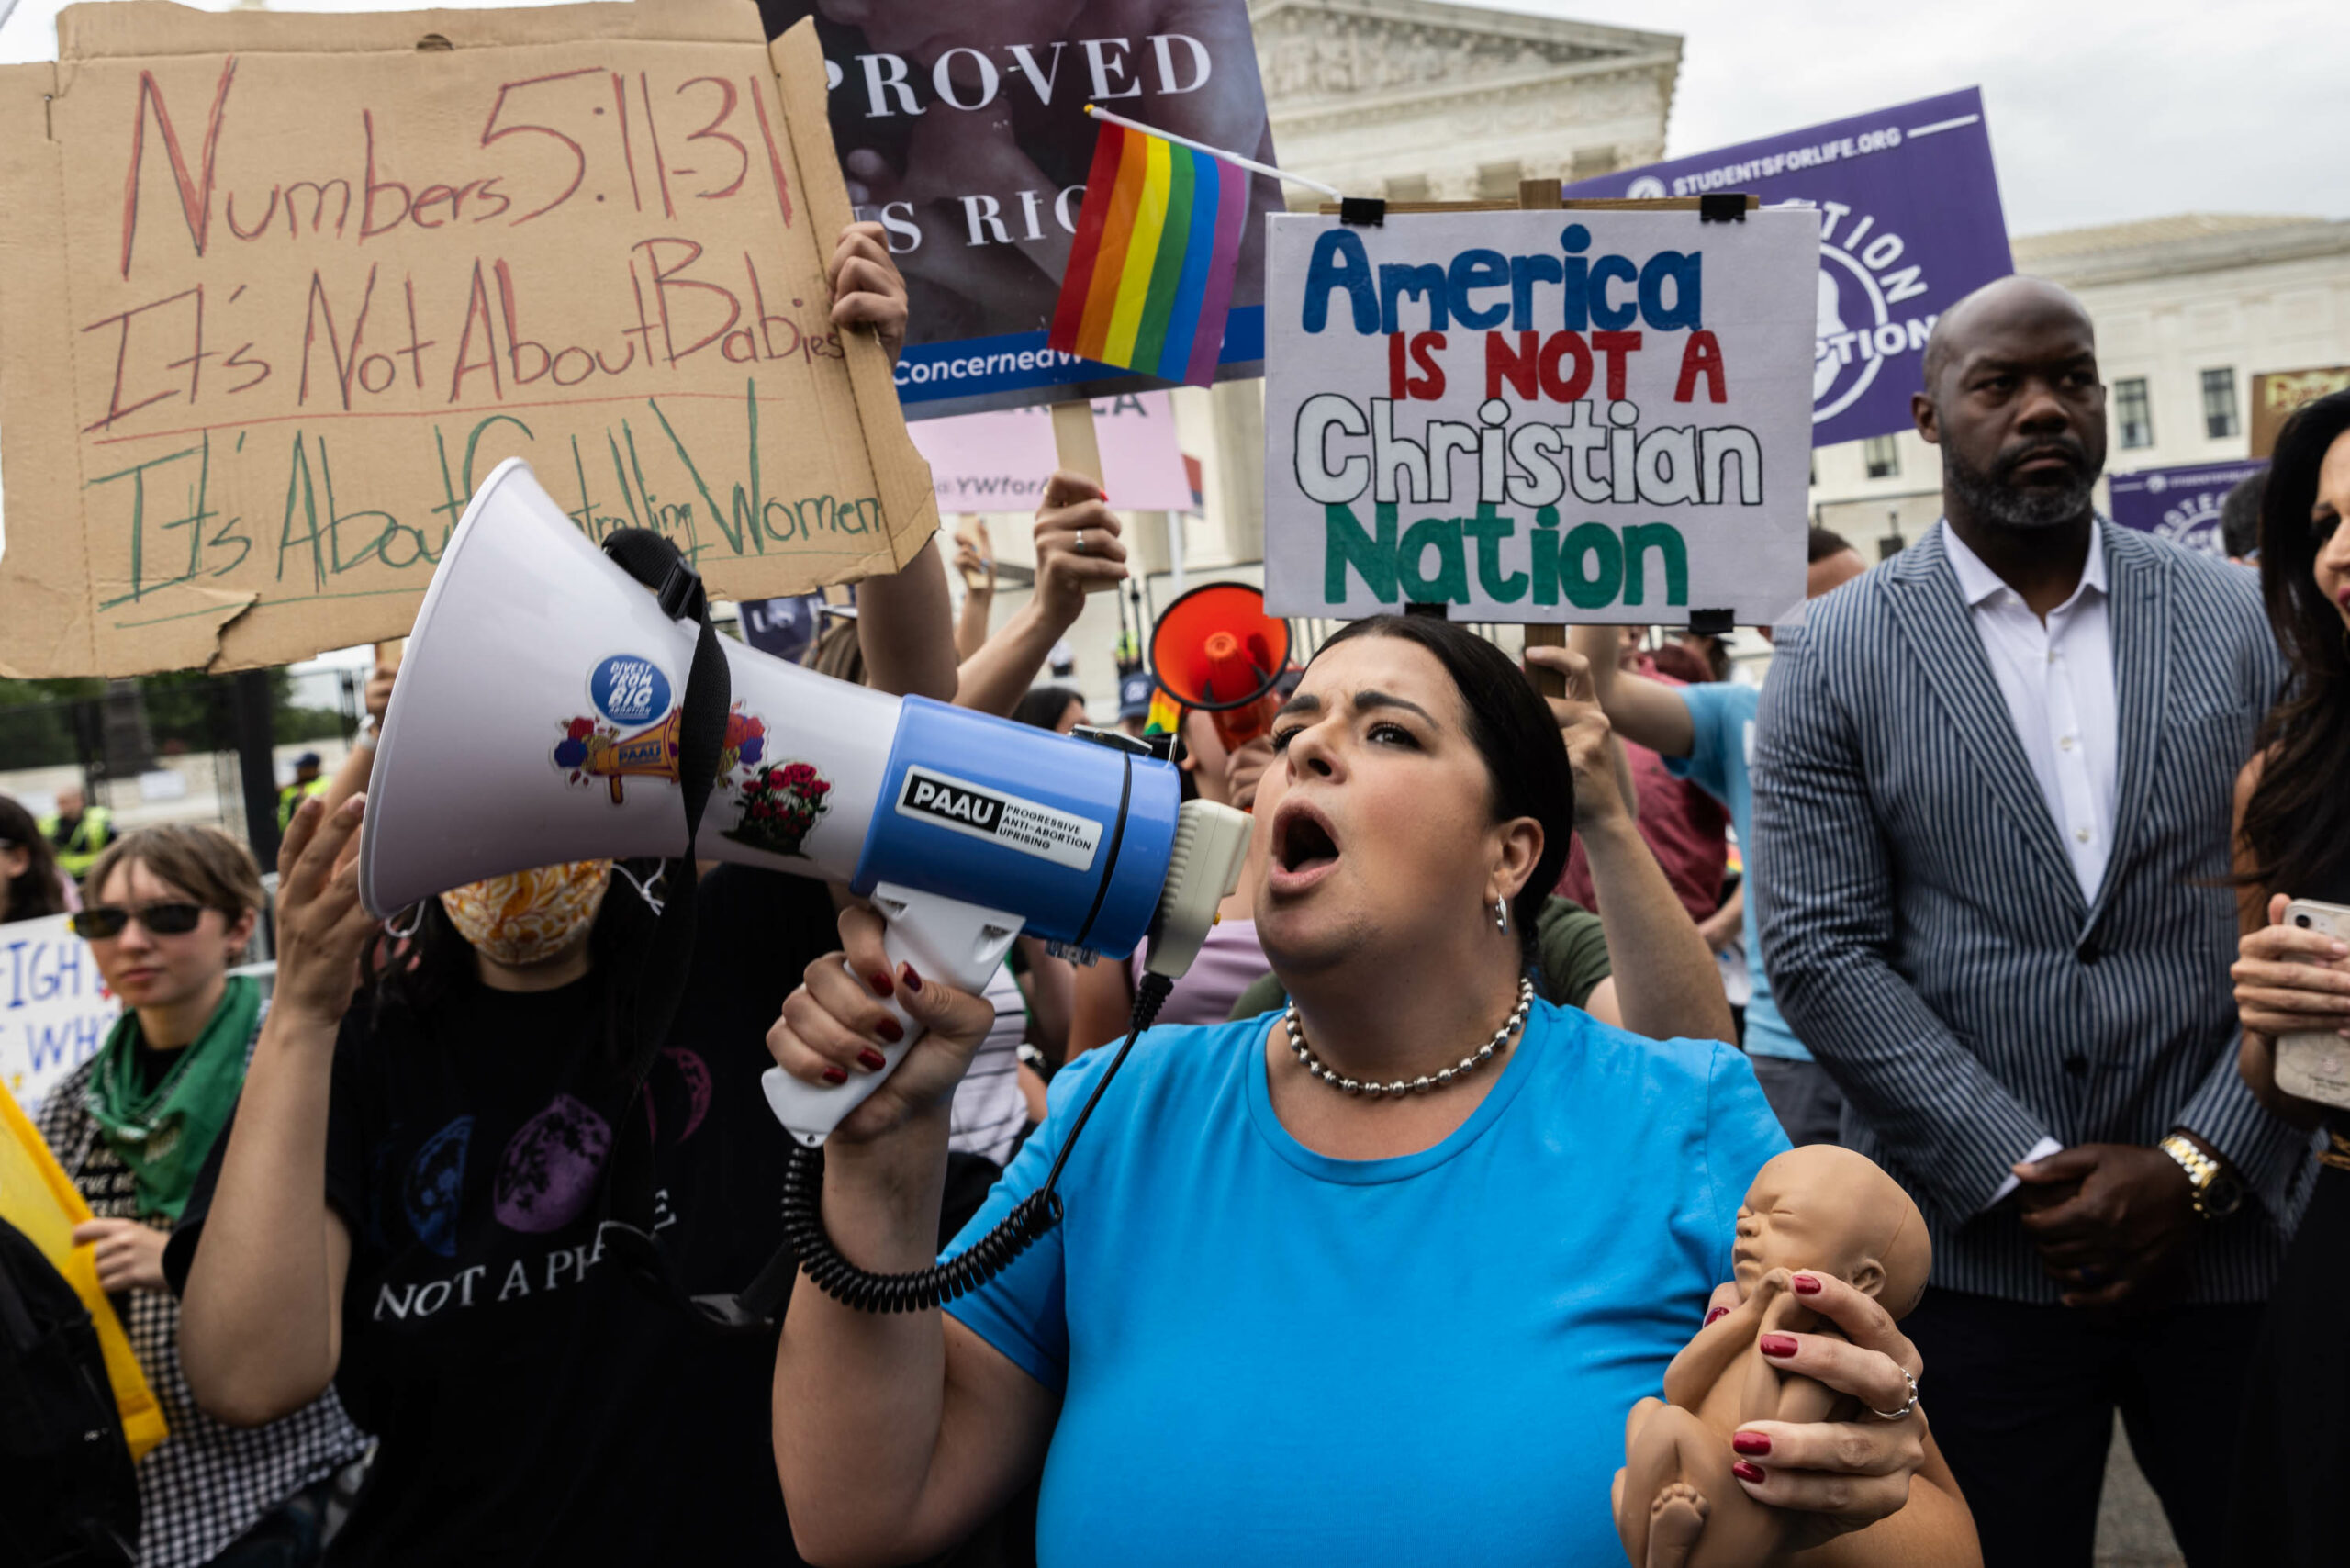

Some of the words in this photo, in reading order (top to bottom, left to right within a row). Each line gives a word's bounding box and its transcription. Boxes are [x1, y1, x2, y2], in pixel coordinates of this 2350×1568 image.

[122, 56, 511, 281] Numbers
[479, 67, 793, 229] 5:11-31
[1673, 127, 1902, 196] STUDENTSFORLIFE.ORG
[1302, 224, 1703, 335] America
[1821, 200, 1928, 304] TION
[82, 283, 272, 432] It's
[297, 261, 435, 411] Not
[448, 257, 661, 404] About
[630, 237, 845, 370] Babies
[1389, 331, 1447, 401] IS
[1485, 330, 1642, 403] NOT
[1673, 330, 1728, 403] A
[1293, 393, 1762, 508] Christian
[84, 427, 252, 613] It's
[277, 423, 470, 593] About
[463, 415, 714, 569] Ctrolling
[648, 377, 883, 555] Women
[1324, 502, 1688, 610] Nation
[608, 686, 653, 709] BIG
[913, 780, 995, 825] PAAU
[999, 827, 1051, 850] UPRISING
[1002, 816, 1092, 851] ANTI-ABORTION
[1006, 804, 1081, 835] PROGRESSIVE
[374, 1264, 487, 1322] NOT
[498, 1260, 532, 1302] A
